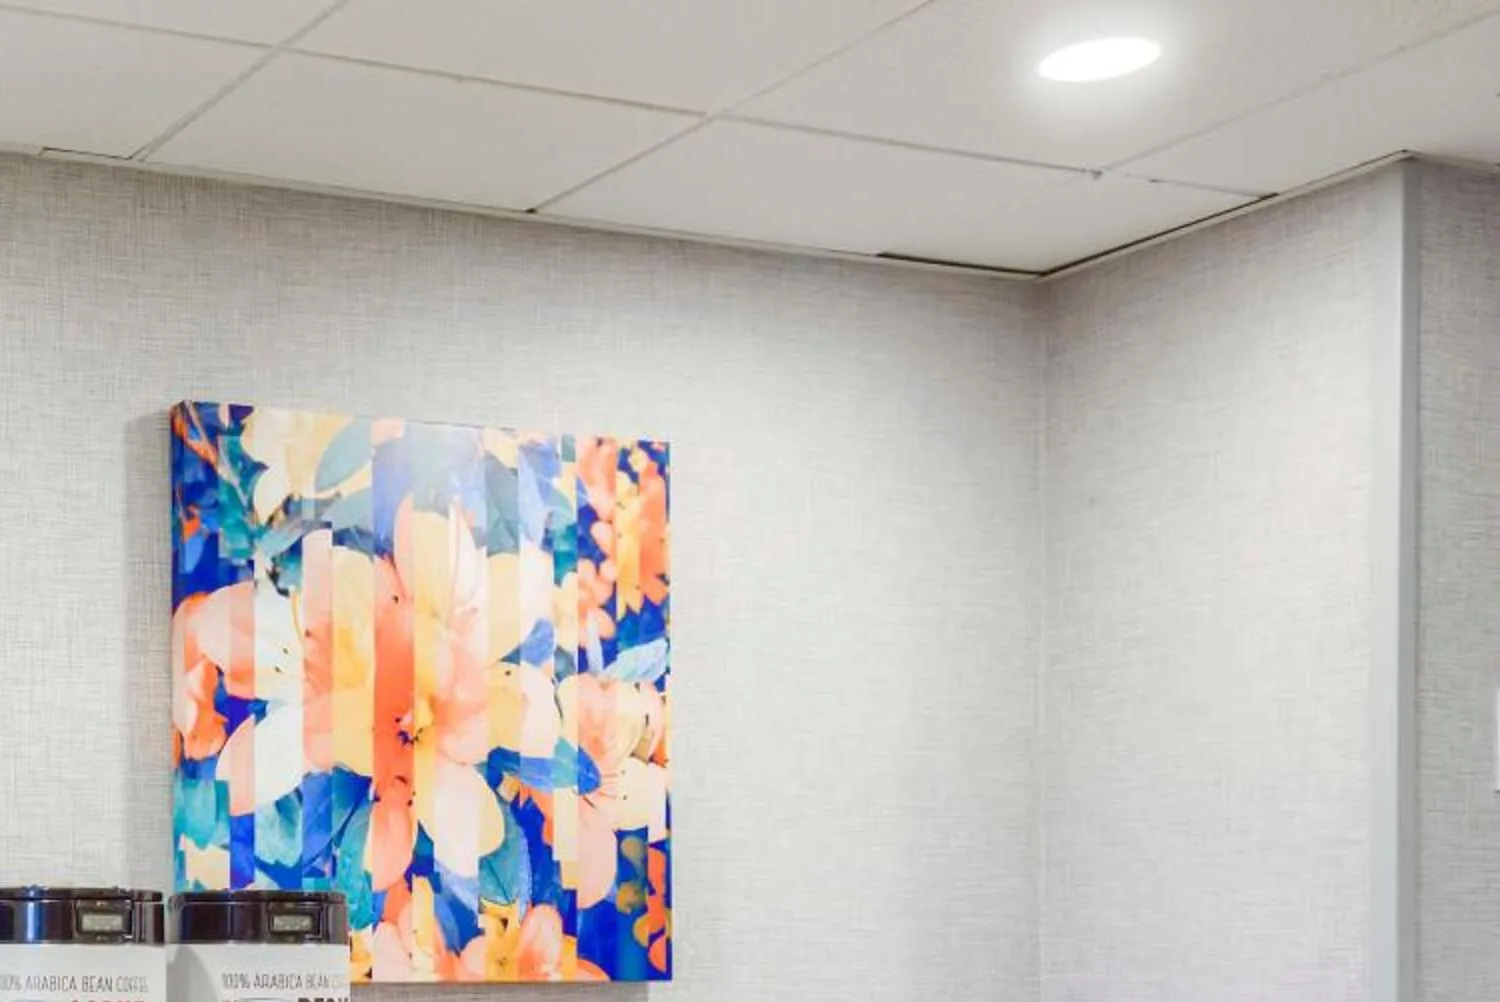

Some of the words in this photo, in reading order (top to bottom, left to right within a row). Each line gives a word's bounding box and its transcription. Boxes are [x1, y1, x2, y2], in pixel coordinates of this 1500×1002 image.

[25, 975, 77, 992] ARABICA
[81, 975, 113, 993] BEAN
[253, 973, 302, 991] ARABICA
